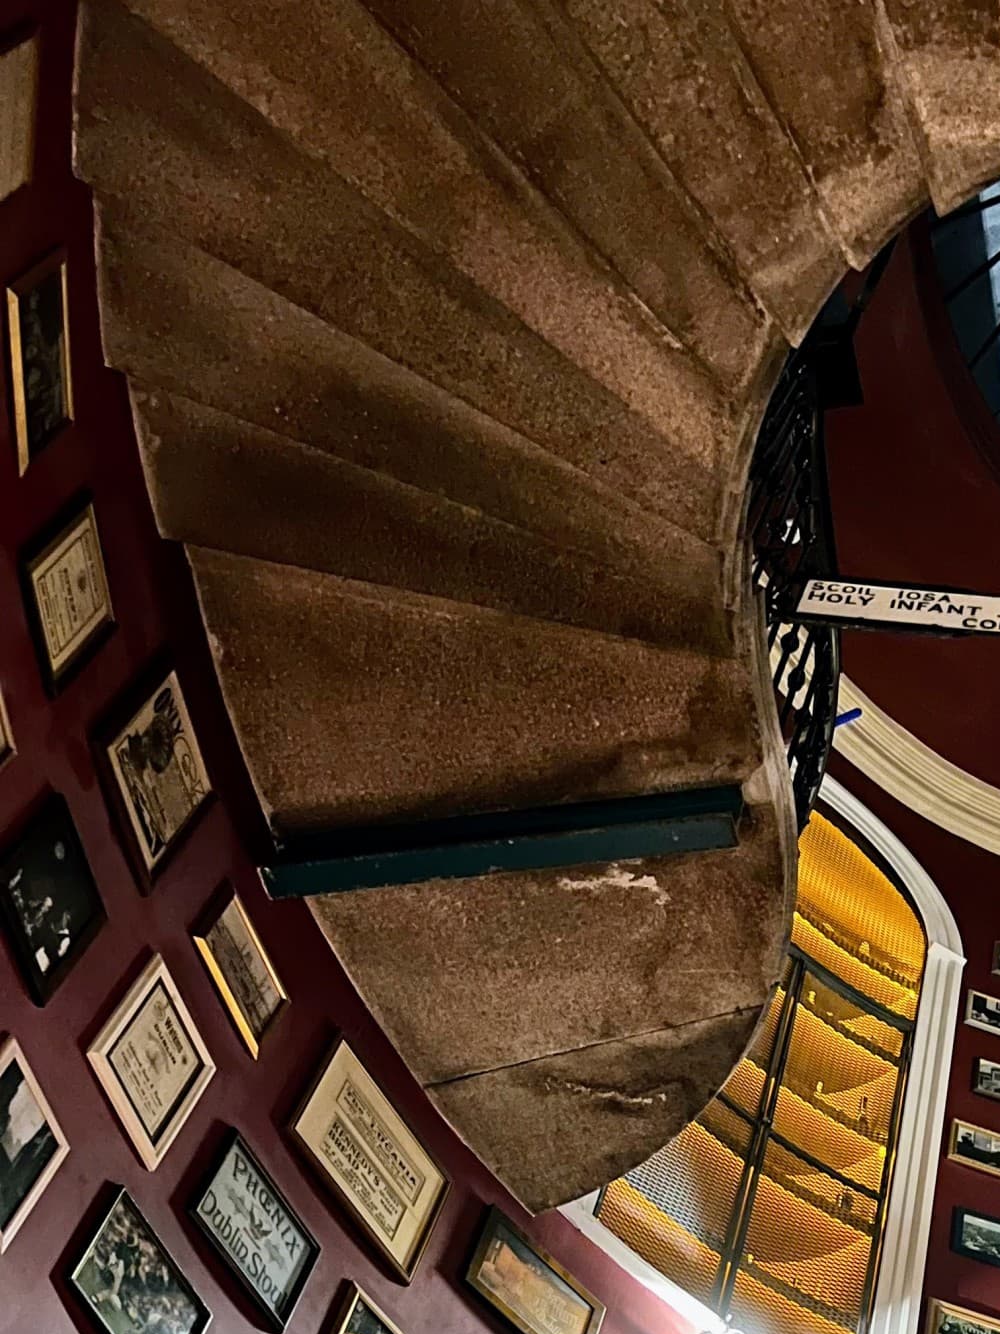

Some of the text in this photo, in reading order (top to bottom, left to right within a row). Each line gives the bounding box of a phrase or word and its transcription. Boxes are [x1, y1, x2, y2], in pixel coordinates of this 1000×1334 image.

[812, 582, 875, 596] SCOIL
[808, 591, 874, 606] HOLY
[889, 599, 982, 617] INFANT
[200, 1189, 248, 1263] Dublin
